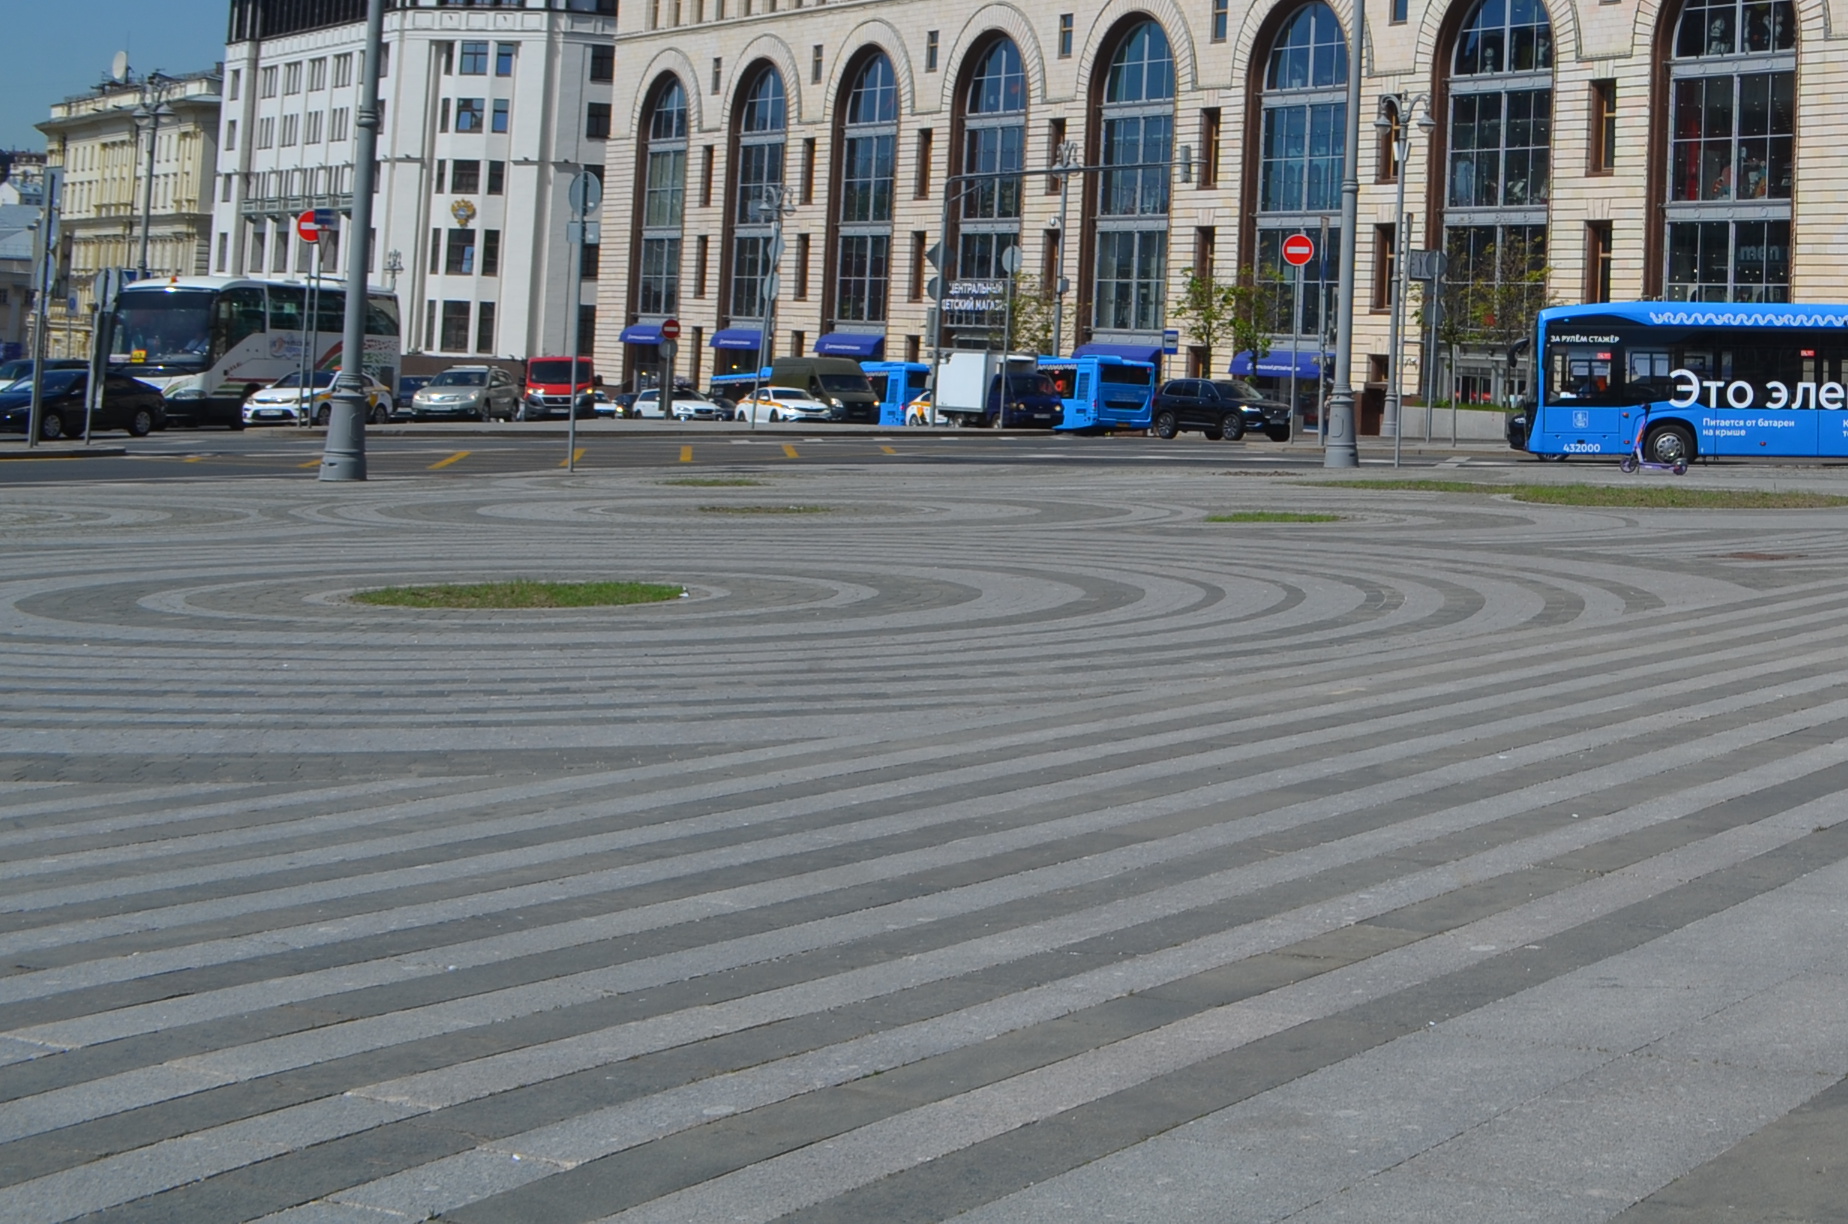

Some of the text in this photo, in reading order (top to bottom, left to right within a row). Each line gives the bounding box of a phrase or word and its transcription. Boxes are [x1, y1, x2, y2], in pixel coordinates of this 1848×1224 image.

[1550, 334, 1620, 343] ЗА РУЛЁМ СТАЖЁР
[1668, 369, 1754, 409] Это
[1702, 417, 1795, 428] Питается от батареи
[1715, 429, 1746, 437] крыше
[1563, 443, 1601, 453] 432000
